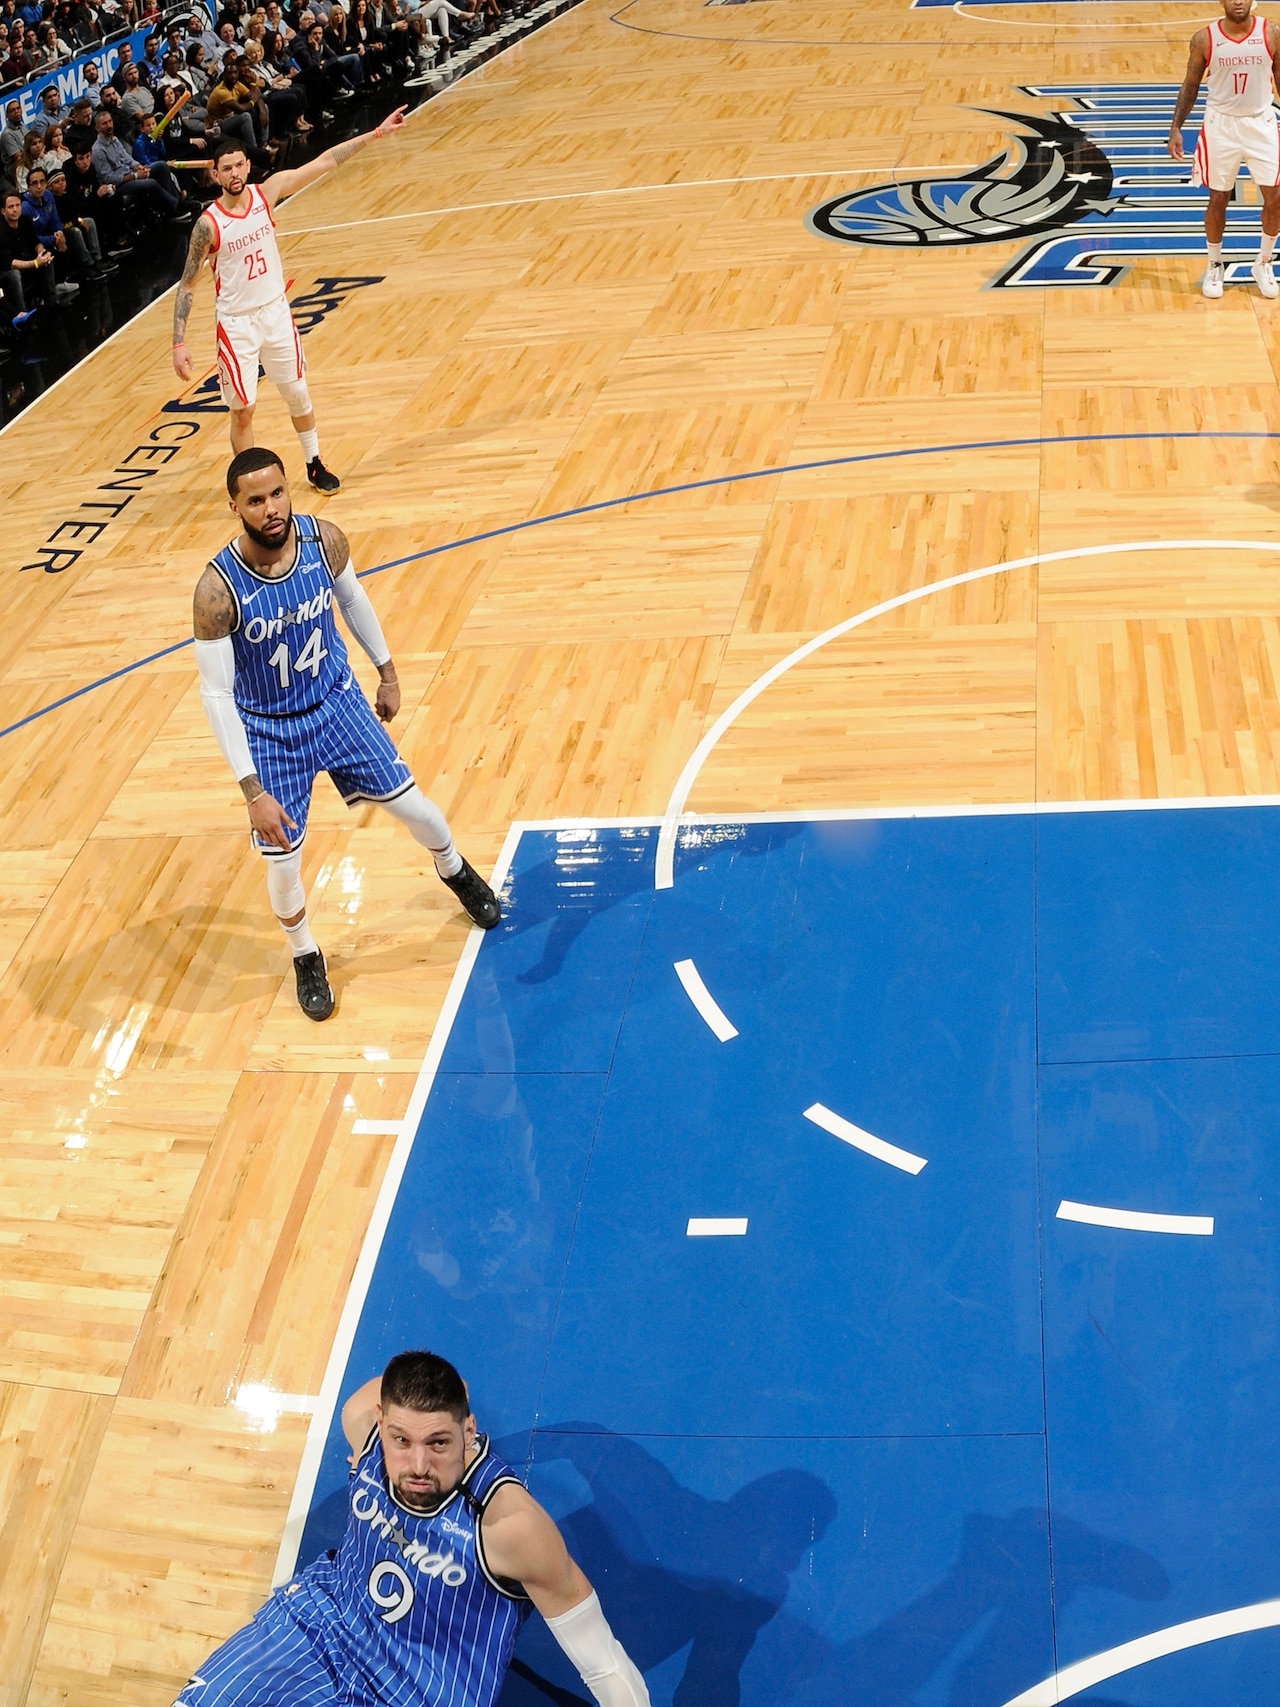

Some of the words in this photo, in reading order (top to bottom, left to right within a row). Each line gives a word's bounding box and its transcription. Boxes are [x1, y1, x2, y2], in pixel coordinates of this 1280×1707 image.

[1219, 56, 1262, 67] ROCKETS
[1233, 73, 1248, 94] 17
[227, 224, 270, 253] ROCKETS
[244, 249, 268, 281] 25
[19, 421, 200, 573] CENTER
[268, 628, 328, 689] 14
[441, 1516, 473, 1539] Disney
[368, 1560, 415, 1624] 9
